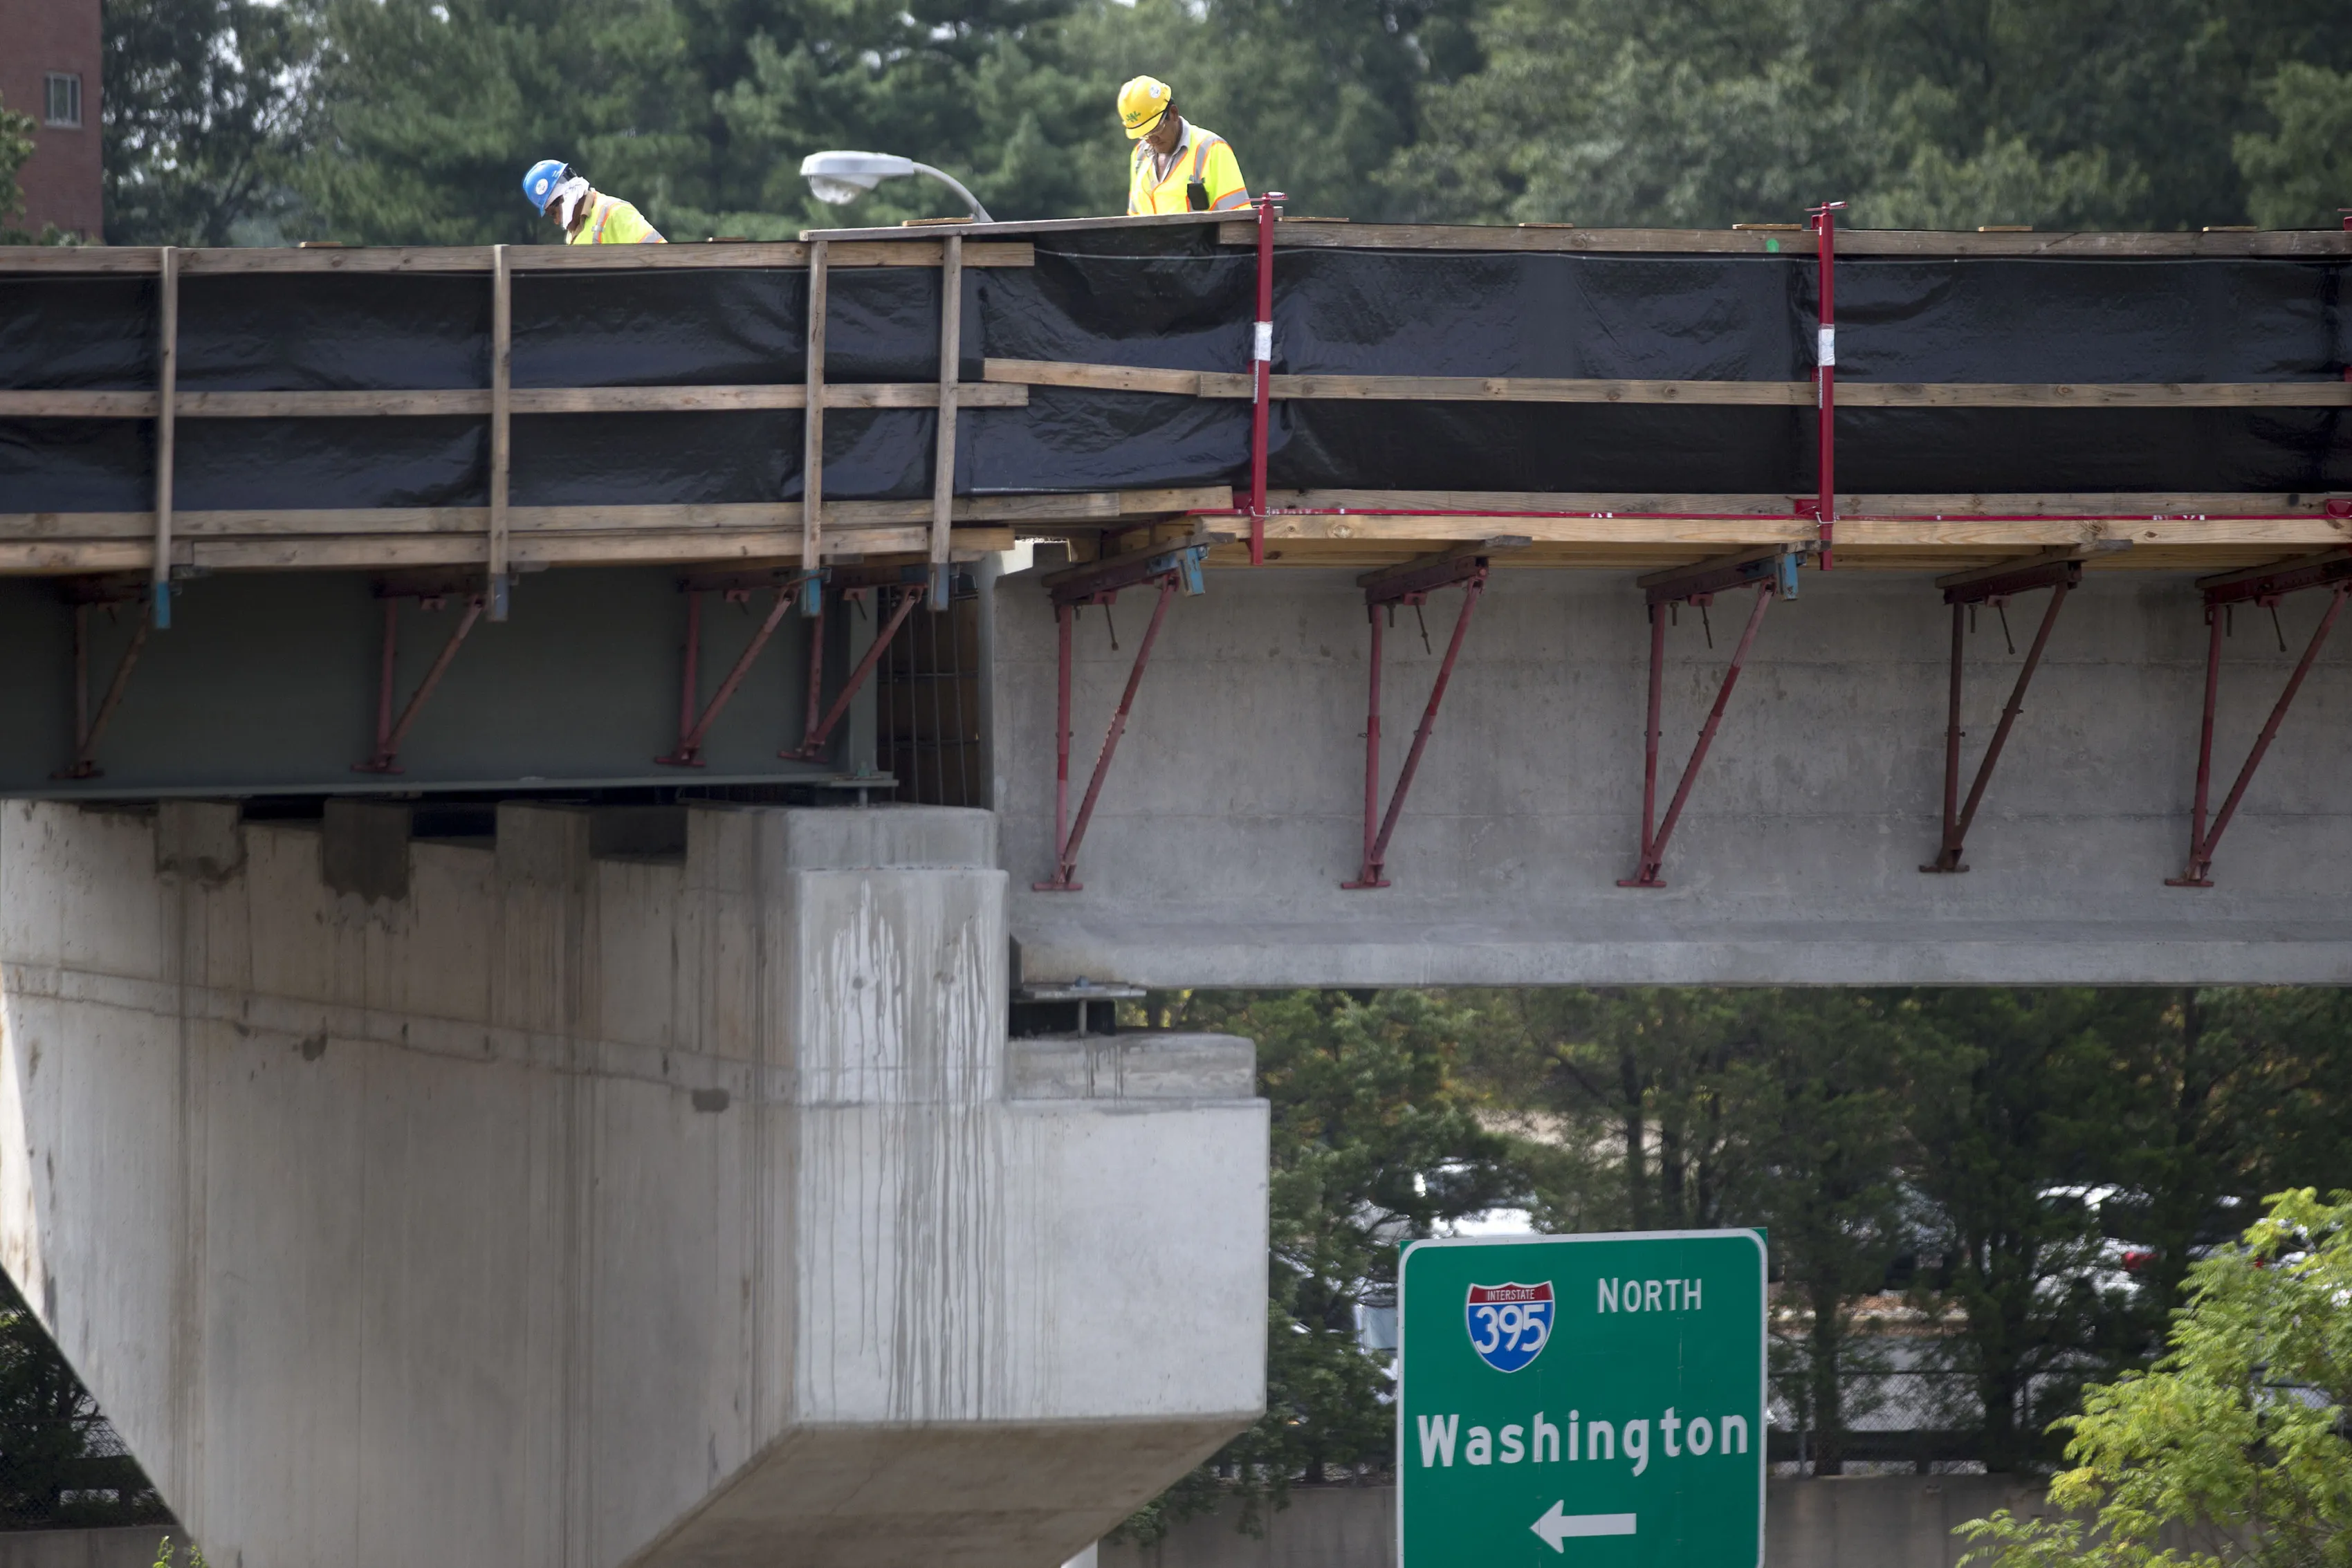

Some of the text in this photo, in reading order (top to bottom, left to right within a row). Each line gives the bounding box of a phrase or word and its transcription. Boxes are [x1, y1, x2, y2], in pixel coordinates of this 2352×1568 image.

[1487, 1288, 1536, 1302] INTERSTATE
[1597, 1277, 1702, 1313] NORTH
[1474, 1303, 1547, 1354] 395
[1416, 1406, 1748, 1477] Washington
